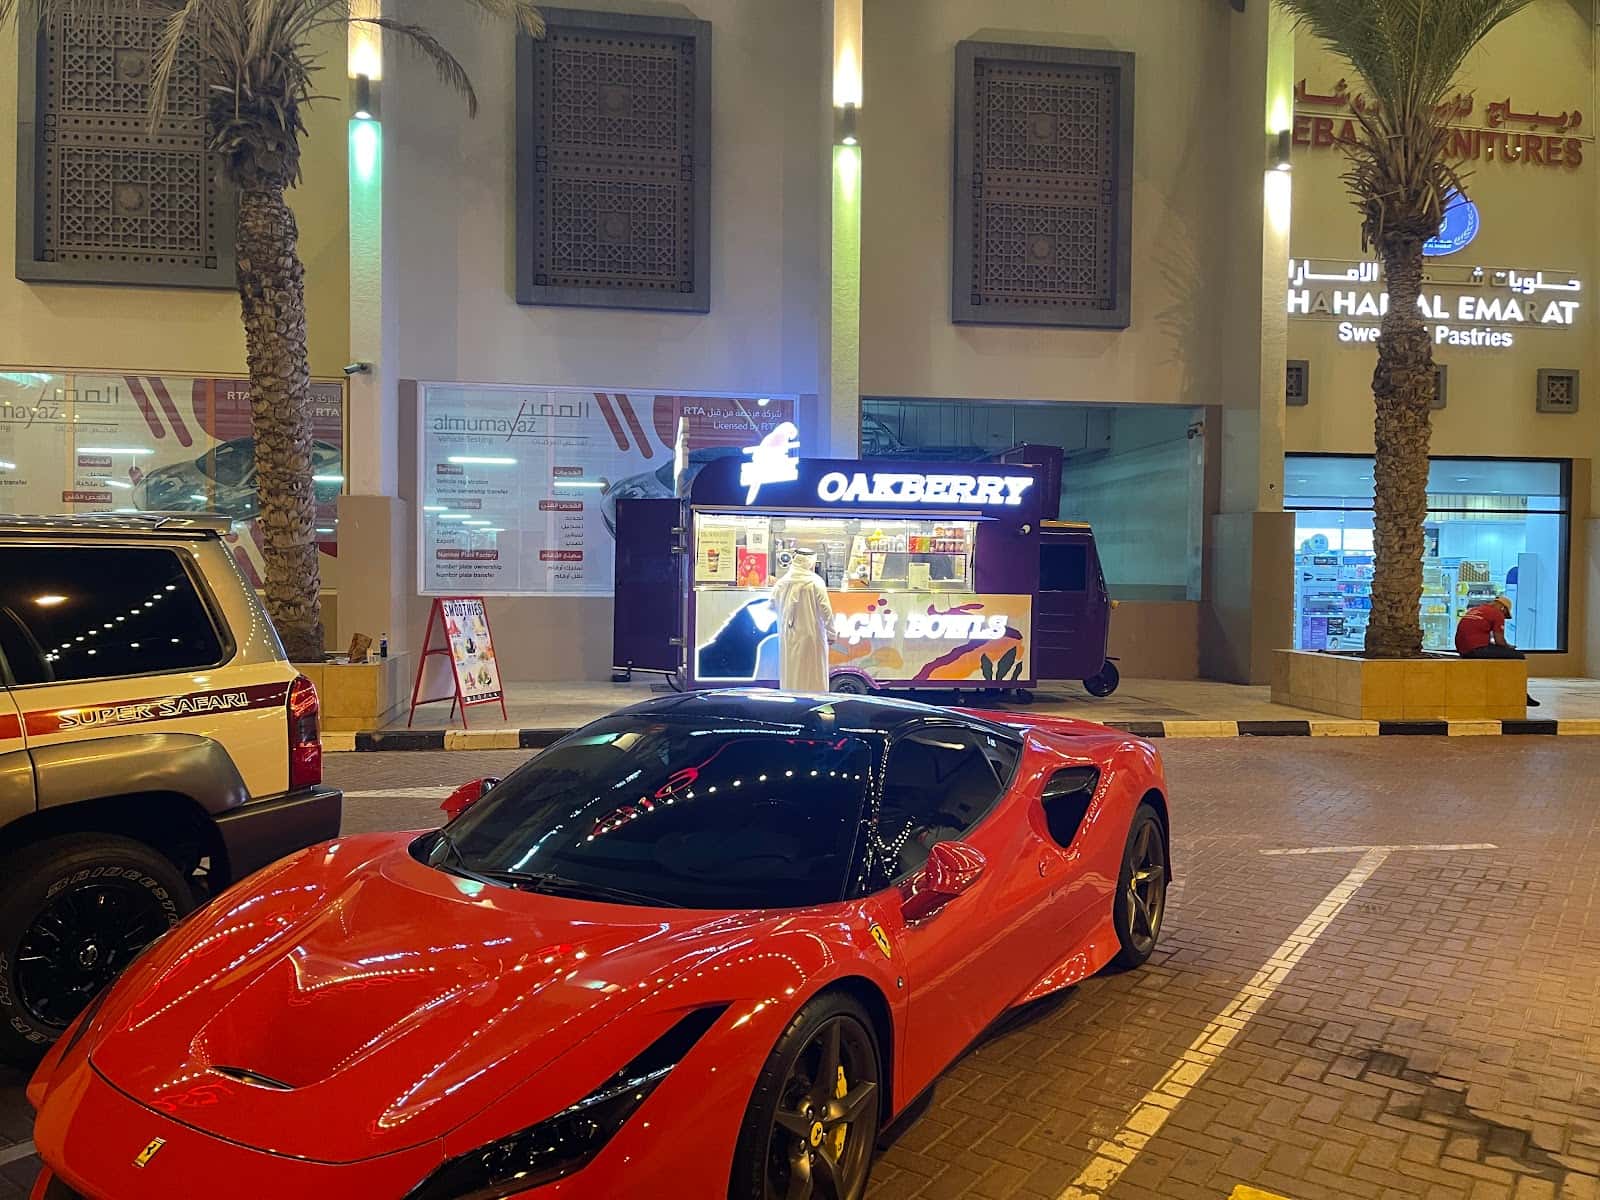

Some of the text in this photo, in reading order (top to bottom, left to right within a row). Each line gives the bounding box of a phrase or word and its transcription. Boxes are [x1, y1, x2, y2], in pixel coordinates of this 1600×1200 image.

[1292, 117, 1583, 168] EBA NITURES
[1288, 259, 1379, 287] الامارا
[1490, 270, 1581, 294] حلويات
[1288, 289, 1390, 316] HAHA
[1458, 295, 1580, 324] EMARAT
[1339, 321, 1513, 347] Swe Pastries
[316, 408, 340, 417] RTA
[683, 406, 706, 415] RTA
[433, 413, 537, 441] almumayaz
[713, 420, 748, 430] Licensed
[761, 422, 777, 431] RT
[817, 472, 1034, 505] OAKBERRY
[444, 603, 483, 617] SMOOTHIES
[903, 614, 1009, 640] BOWLS
[59, 693, 249, 729] SUPER SAFARI
